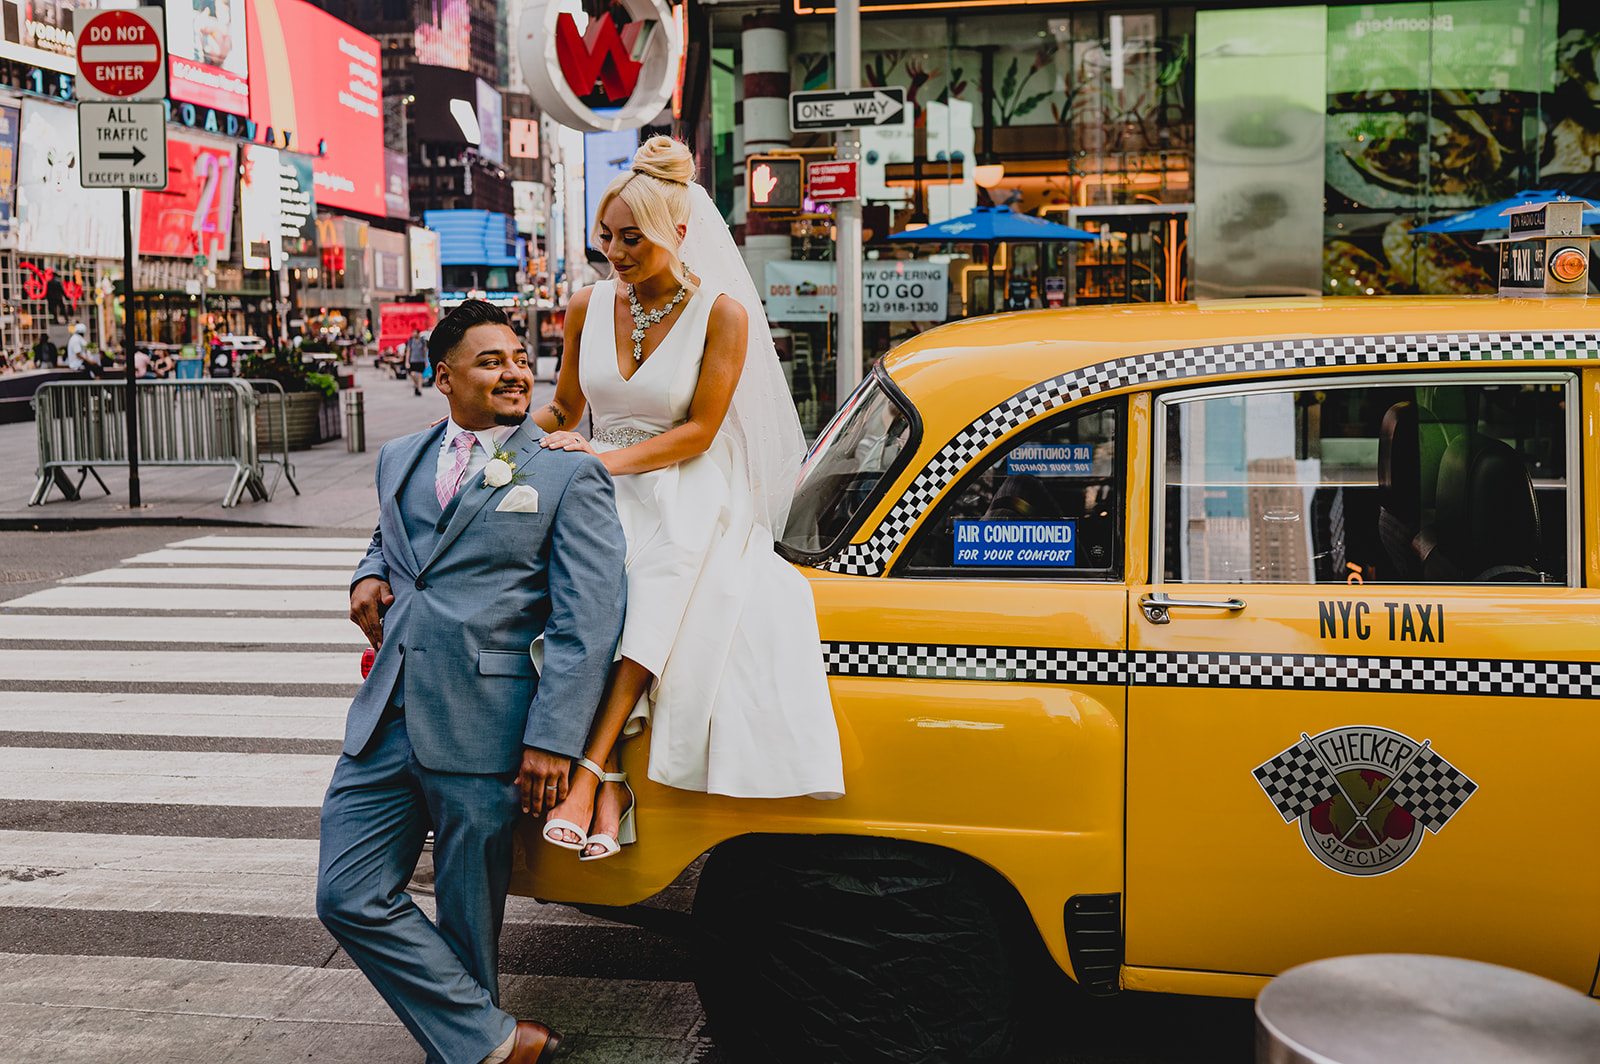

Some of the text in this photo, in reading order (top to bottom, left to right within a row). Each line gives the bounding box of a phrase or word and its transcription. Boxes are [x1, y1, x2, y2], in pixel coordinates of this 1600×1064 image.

[25, 19, 76, 48] VORNA
[90, 25, 145, 41] DO NOT
[96, 65, 144, 81] ENTER
[107, 107, 136, 123] ALL
[801, 100, 889, 119] ONE WAY
[97, 127, 148, 142] TRAFFIC
[88, 172, 158, 184] EXCEPT BIKES
[1513, 212, 1545, 228] ON RADIO CALL
[1534, 249, 1544, 263] OFF
[1512, 248, 1531, 281] TAXI
[880, 269, 942, 280] OFFERING
[1533, 267, 1544, 281] DUTY
[770, 284, 791, 296] DOS
[865, 283, 924, 299] TO GO
[957, 525, 1072, 543] AIR CONDITIONED
[957, 549, 1072, 562] FOR YOUR COMFORT
[1318, 600, 1445, 643] NYC TAXI
[1318, 733, 1413, 772] CHECKER
[1321, 836, 1401, 865] SPECIAL
